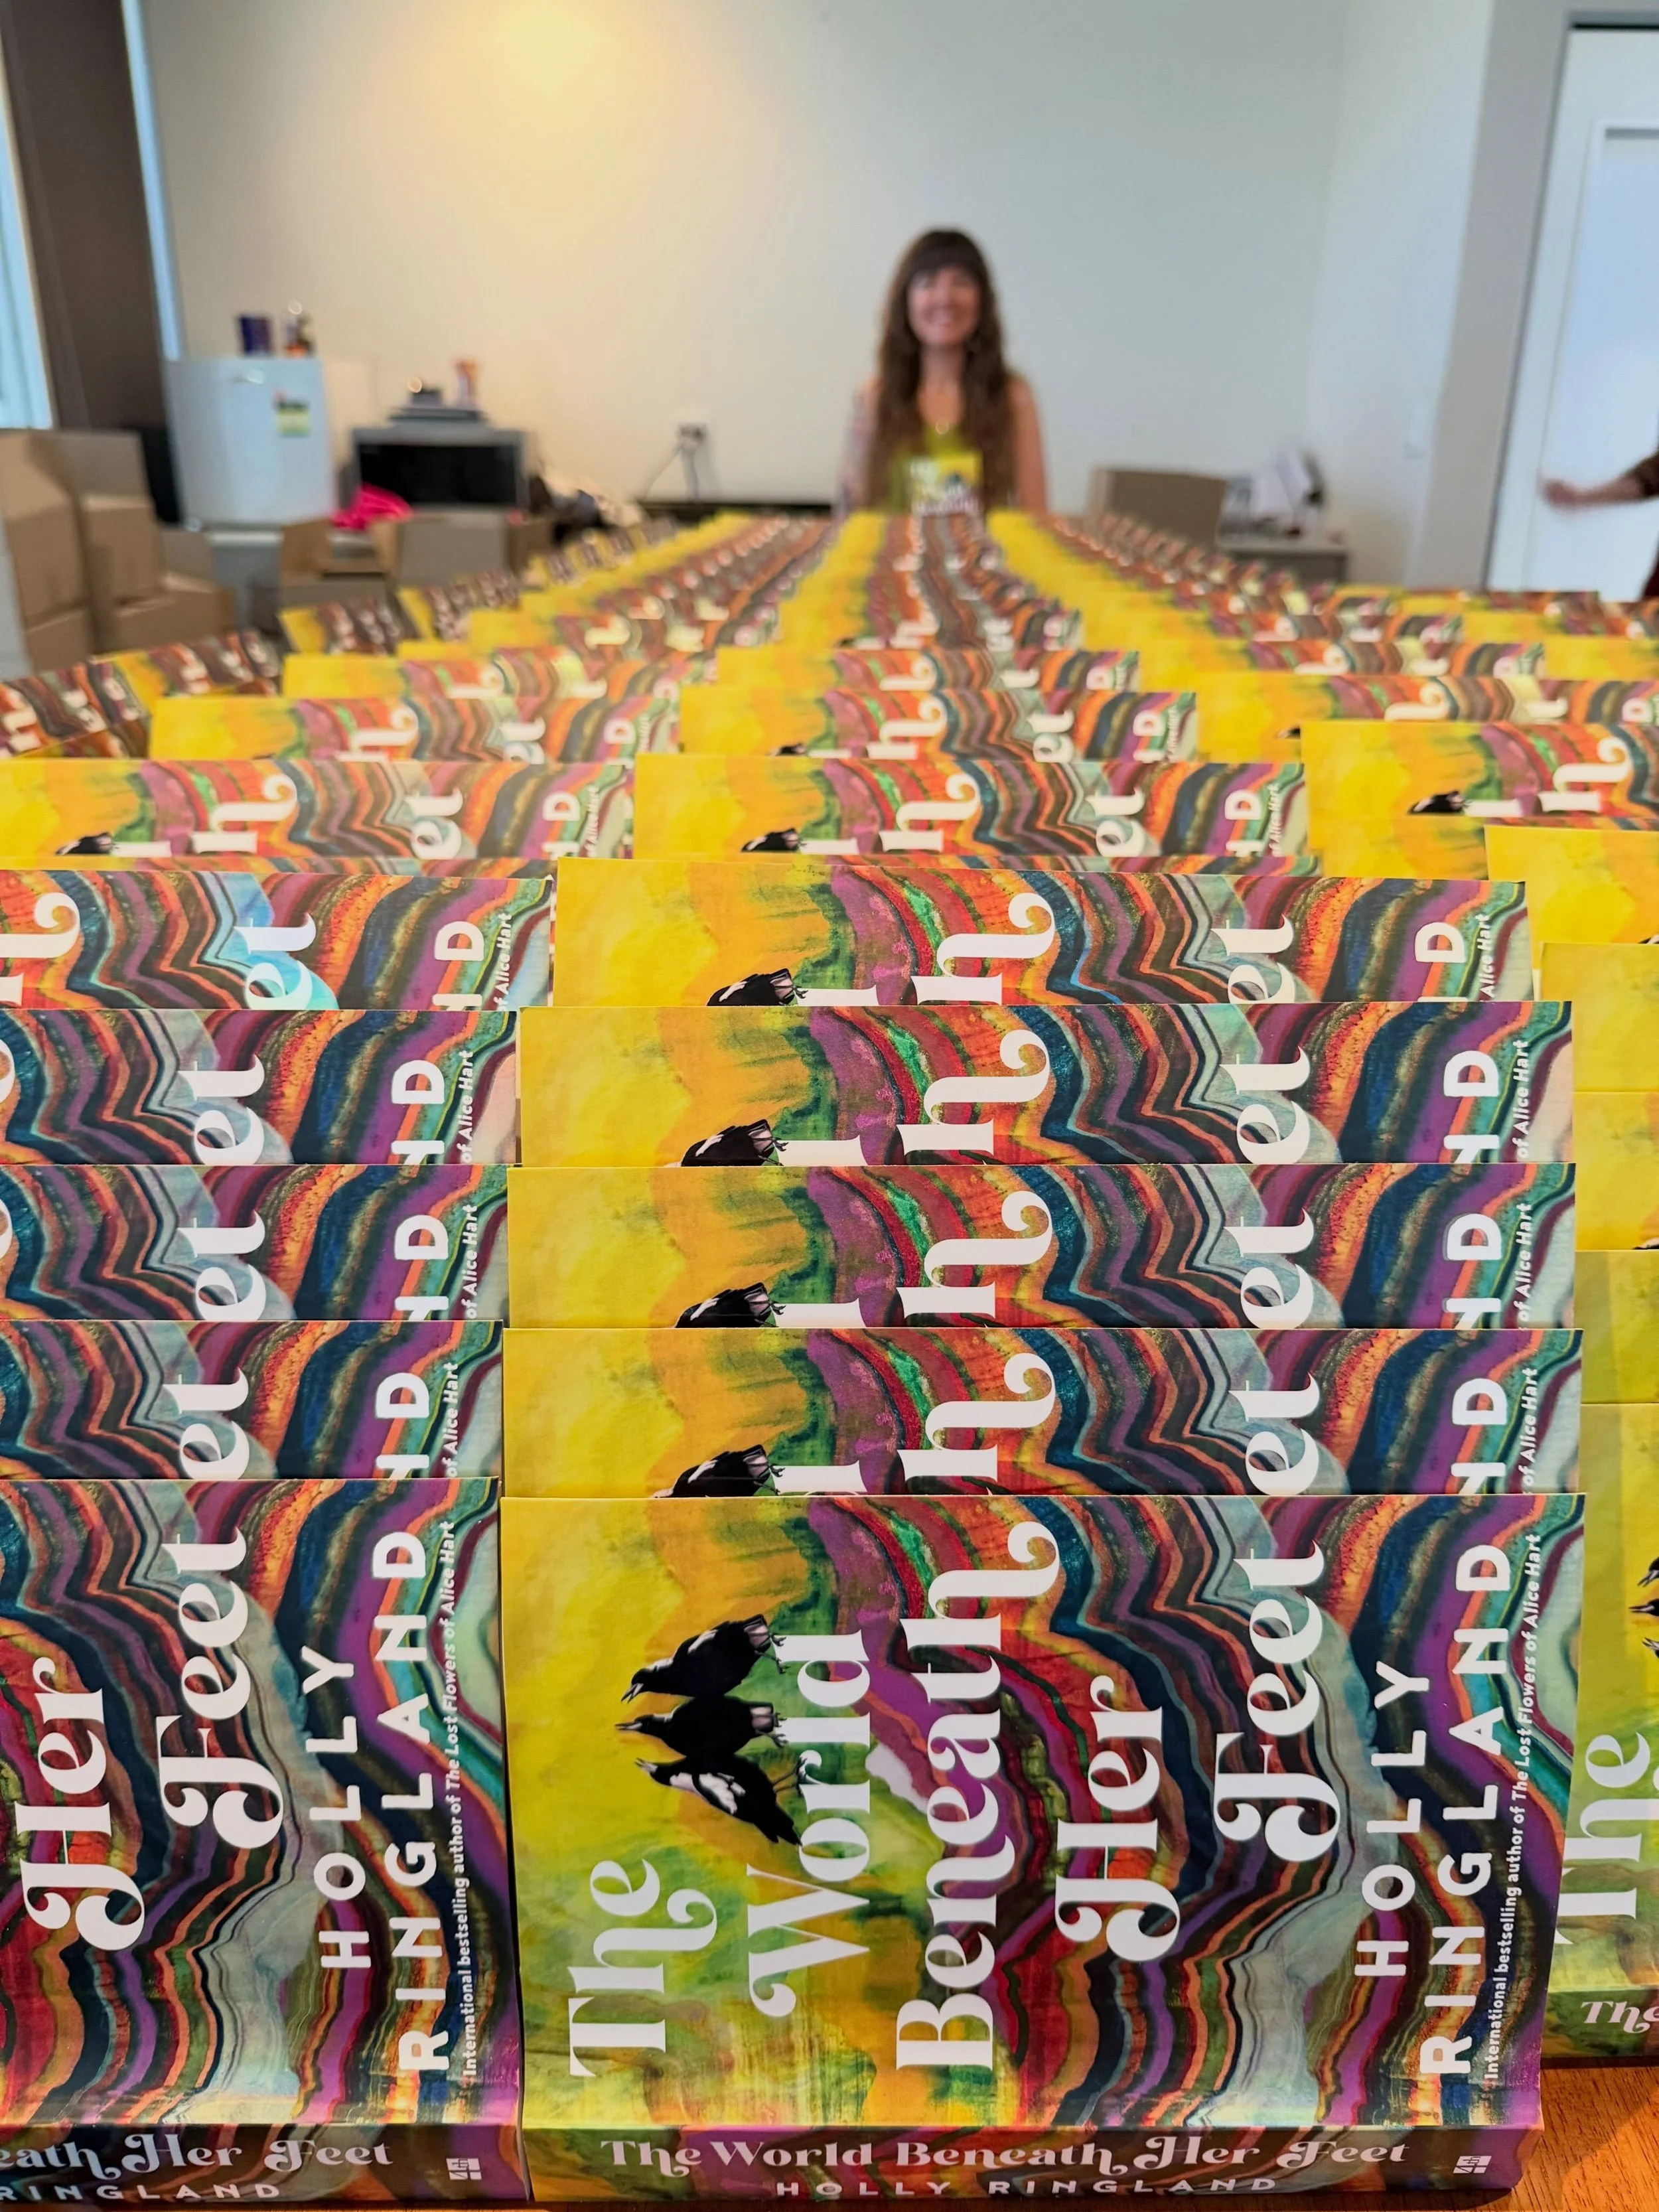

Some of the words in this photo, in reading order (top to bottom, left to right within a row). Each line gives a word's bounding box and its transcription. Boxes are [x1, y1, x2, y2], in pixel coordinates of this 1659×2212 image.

[403, 786, 463, 859] et
[1084, 786, 1145, 857] et
[496, 913, 512, 950] Hart
[1475, 914, 1491, 951] Hart
[234, 912, 316, 1009] et
[496, 954, 510, 995] Alice
[1210, 913, 1295, 1003] et
[1478, 955, 1494, 998] Alice
[459, 1051, 472, 1090] Hart
[1513, 1039, 1528, 1082] Hart
[177, 1053, 265, 1164] et
[458, 1095, 472, 1140] Alice
[1218, 1045, 1311, 1163] et
[1512, 1087, 1529, 1136] Alice
[457, 1143, 472, 1163] of
[1512, 1138, 1528, 1158] of
[463, 1205, 477, 1246] Hart
[1516, 1203, 1532, 1246] Hart
[177, 1209, 265, 1321] et
[462, 1250, 477, 1296] Alice
[1223, 1207, 1315, 1328] et
[1514, 1250, 1532, 1299] Alice
[461, 1298, 476, 1319] of
[1514, 1300, 1530, 1322] of
[443, 1363, 459, 1404] Hart
[1521, 1367, 1538, 1411] Hart
[161, 1366, 250, 1479] et
[443, 1408, 458, 1455] Alice
[1229, 1372, 1320, 1495] et
[1520, 1414, 1536, 1463] Alice
[442, 1457, 458, 1478] of
[1518, 1465, 1535, 1487] of
[439, 1520, 455, 1565] Hart
[1524, 1534, 1541, 1578] Hart
[439, 1567, 455, 1617] Alice
[1522, 1580, 1540, 1629] Alice
[439, 1617, 455, 1639] of
[1521, 1630, 1538, 1651] of
[157, 1526, 285, 1848] Feet
[442, 1641, 459, 1714] Flowers
[1214, 1540, 1340, 1862] Feet
[1518, 1657, 1536, 1724] Flowers
[443, 1715, 459, 1755] Lost
[1514, 1727, 1532, 1768] Lost
[445, 1755, 461, 1792] The
[896, 1520, 1060, 2071] Beneath
[1512, 1768, 1528, 1801] The
[15, 1657, 144, 1951] Her
[301, 1647, 371, 1968] HOLLY
[373, 1531, 449, 2073] RINGLAND
[445, 1795, 461, 1814] of
[747, 1629, 870, 2018] World
[1055, 1675, 1181, 1962] Her
[1354, 1661, 1429, 1976] HOLLY
[1420, 1545, 1510, 2075] RINGLAND
[1510, 1805, 1526, 1826] of
[449, 1816, 465, 1873] author
[1506, 1828, 1524, 1883] author
[451, 1878, 471, 1966] bestselling
[1494, 1886, 1522, 1973] bestselling
[569, 1859, 717, 2077] The
[456, 1970, 476, 2075] International
[1484, 1976, 1506, 2079] International
[1580, 2000, 1659, 2034] The
[0, 2142, 121, 2181] eath
[121, 2134, 242, 2173] Her
[264, 2140, 394, 2173] Feet
[600, 2140, 702, 2177] The
[710, 2140, 872, 2167] World
[897, 2141, 1127, 2175] Beneath
[1133, 2136, 1260, 2170] Her
[1276, 2141, 1409, 2170] Feet
[0, 2184, 279, 2201] RINGLAND
[776, 2181, 952, 2197] HOLLY
[989, 2178, 1276, 2195] RINGLAND
